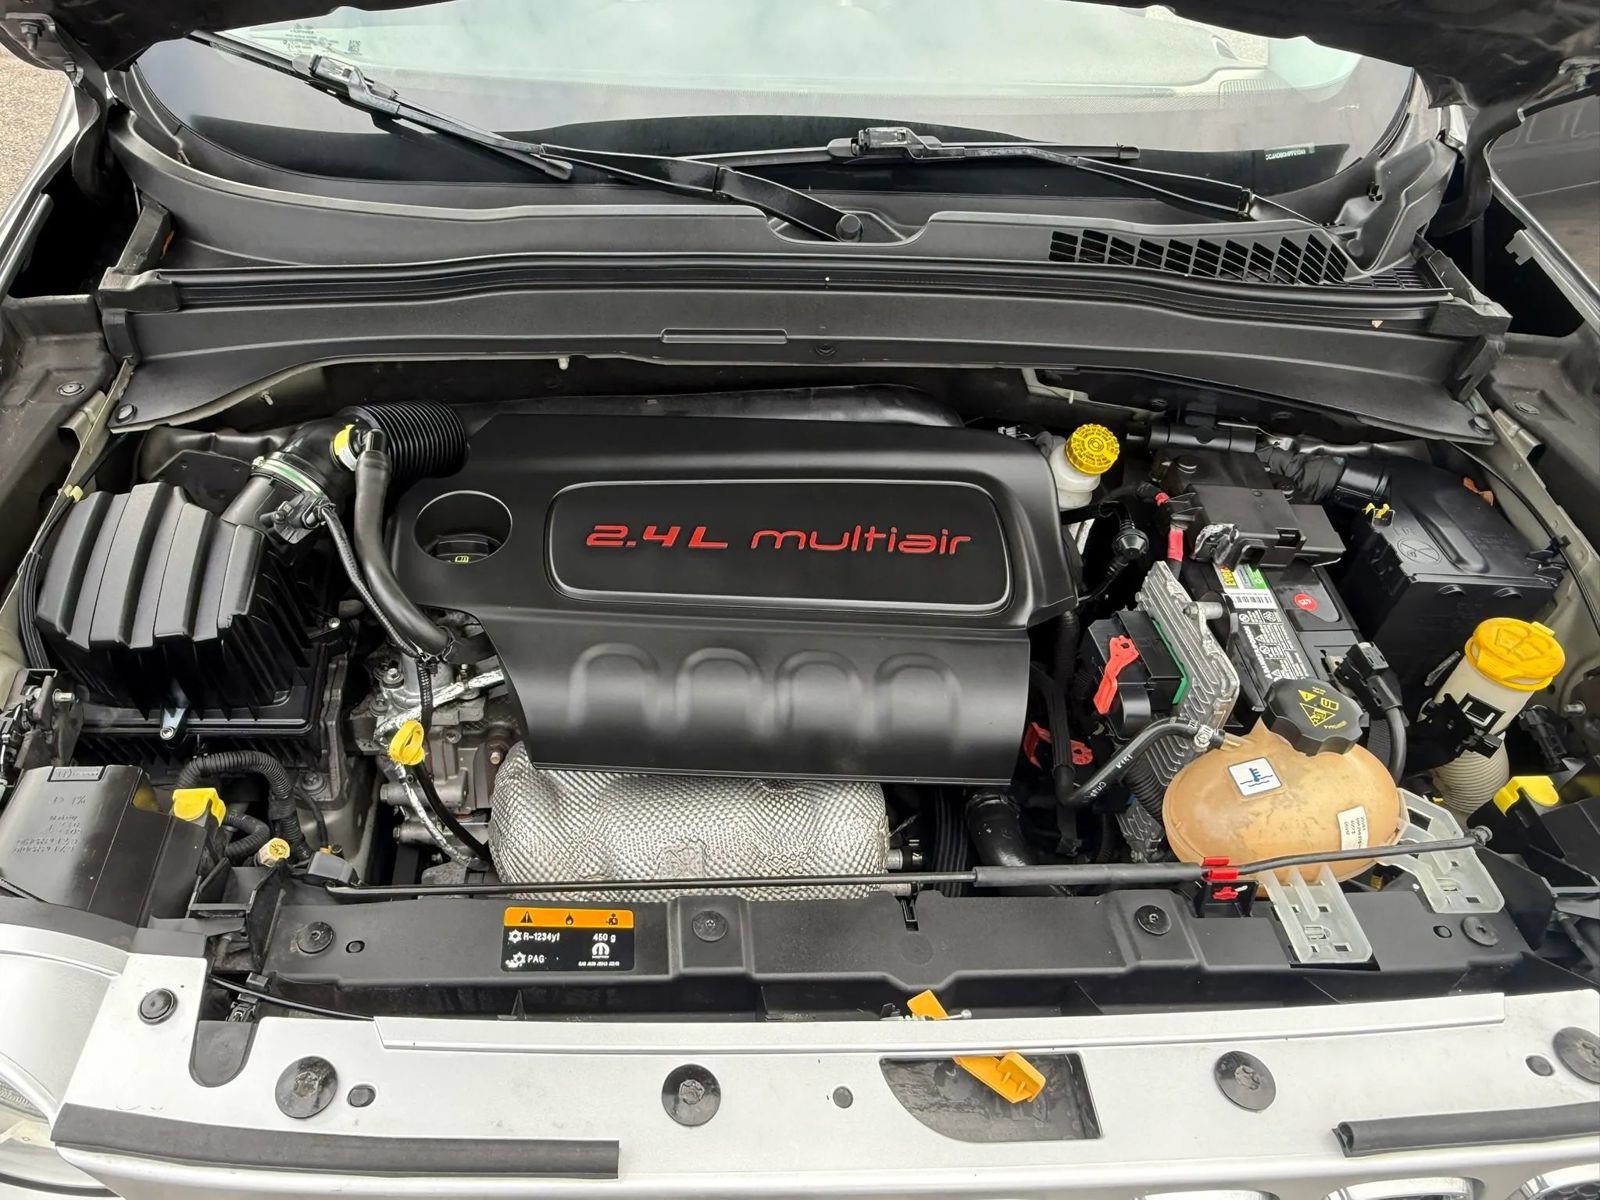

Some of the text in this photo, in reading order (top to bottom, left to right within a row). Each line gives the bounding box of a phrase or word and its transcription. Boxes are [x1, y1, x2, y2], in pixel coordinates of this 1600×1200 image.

[749, 524, 972, 555] multiair
[593, 932, 608, 942] 450
[527, 954, 545, 964] PAG
